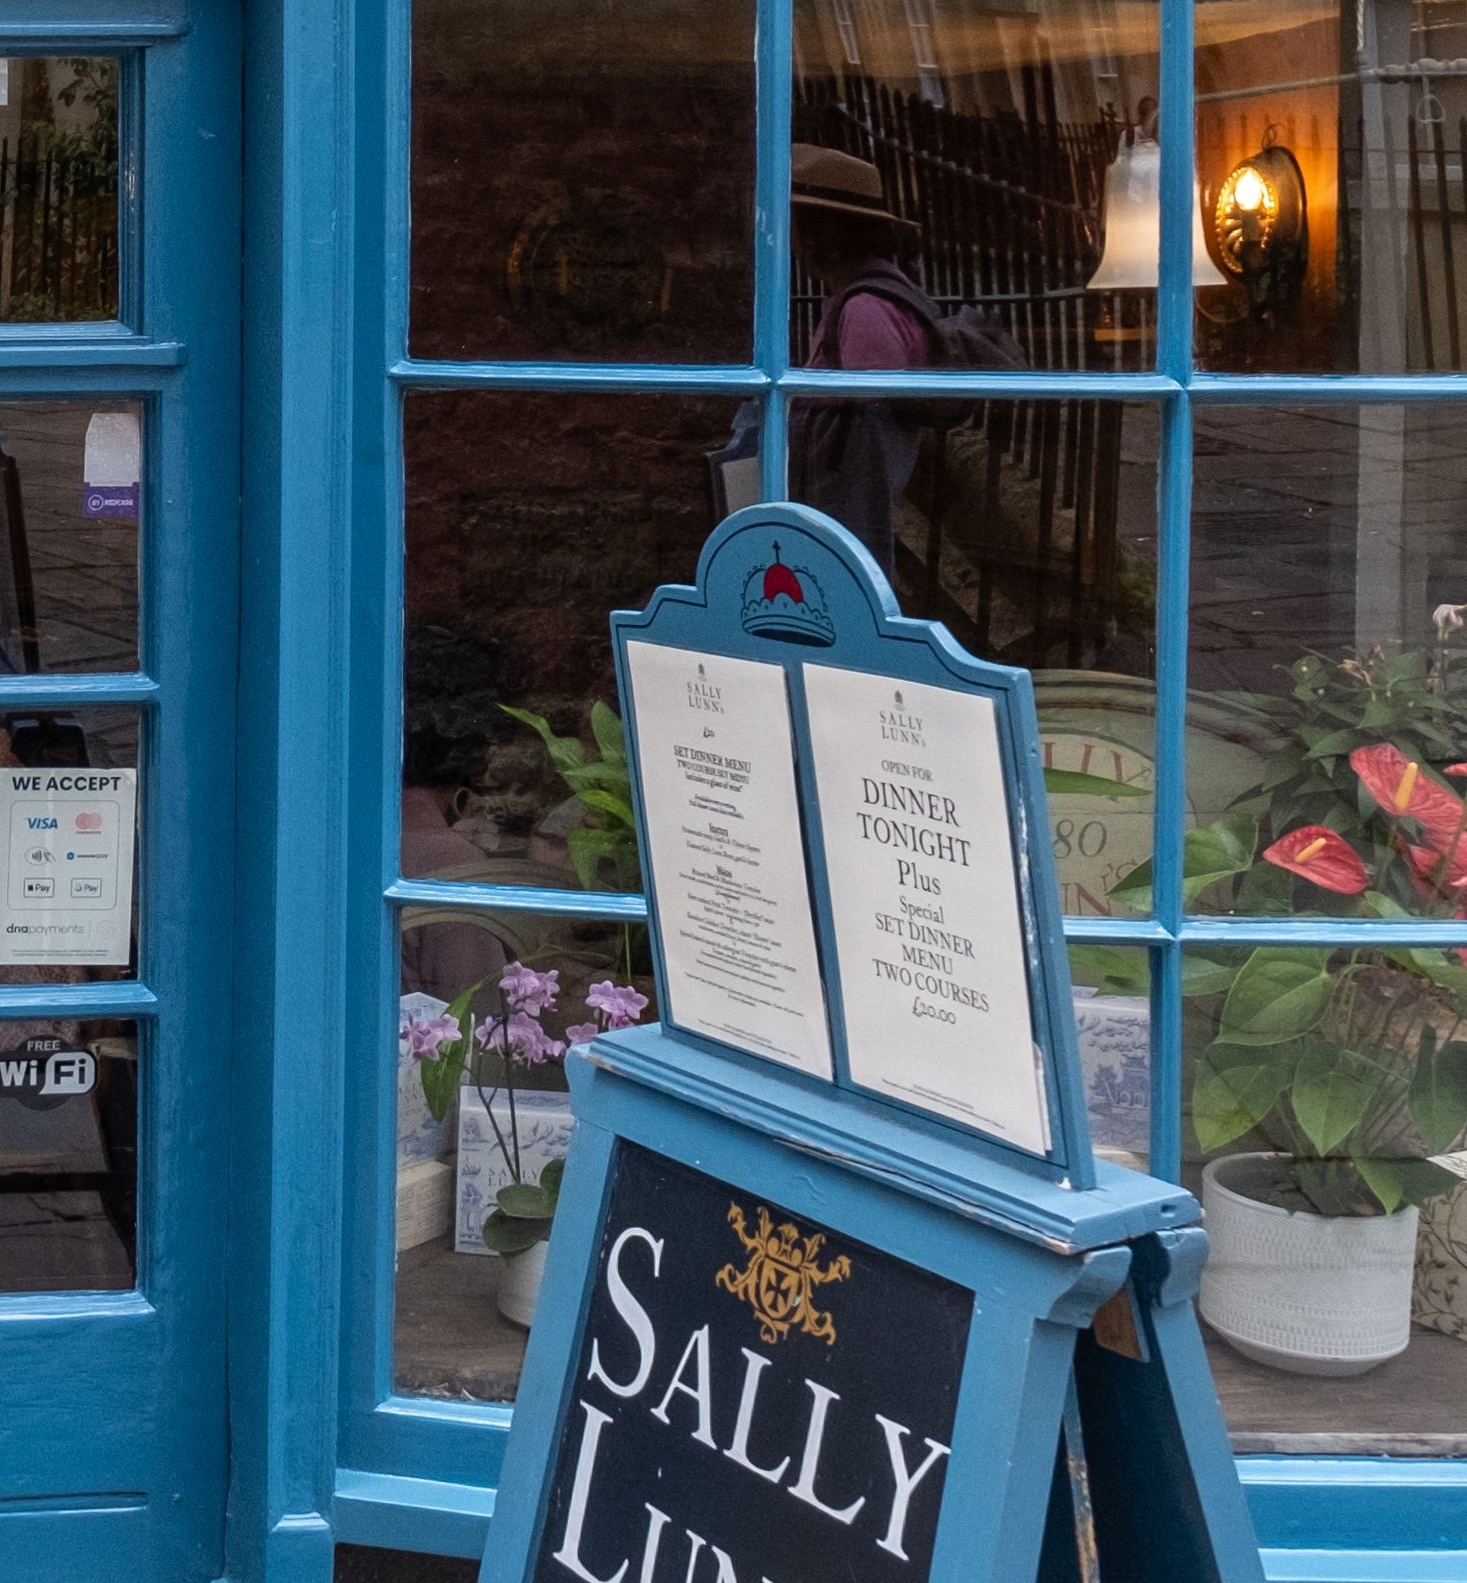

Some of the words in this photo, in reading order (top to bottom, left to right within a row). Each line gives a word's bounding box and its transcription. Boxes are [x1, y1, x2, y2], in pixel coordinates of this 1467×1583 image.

[686, 681, 723, 700] SALLY
[878, 710, 923, 731] SALLY
[673, 744, 688, 758] SET
[691, 748, 724, 767] DINNER
[724, 757, 752, 774] MENU
[881, 759, 911, 777] OPEN
[912, 767, 932, 782] FOR
[12, 776, 41, 791] WE
[45, 776, 122, 791] ACCEPT
[861, 777, 960, 827] DINNER
[26, 817, 59, 830] VISA
[856, 812, 971, 867] TONIGHT
[34, 883, 51, 894] Pay
[84, 883, 99, 894] Pay
[896, 858, 941, 896] Plus
[899, 895, 945, 925] Special
[5, 922, 85, 938] dnapayments
[875, 912, 905, 937] SET
[908, 920, 976, 960] DINNER
[901, 943, 954, 976] MENU
[872, 958, 912, 987] TWO
[914, 971, 990, 1014] COURSES
[911, 996, 957, 1025] £20.00
[27, 1040, 61, 1052] FREE
[587, 1227, 952, 1562] SALLY
